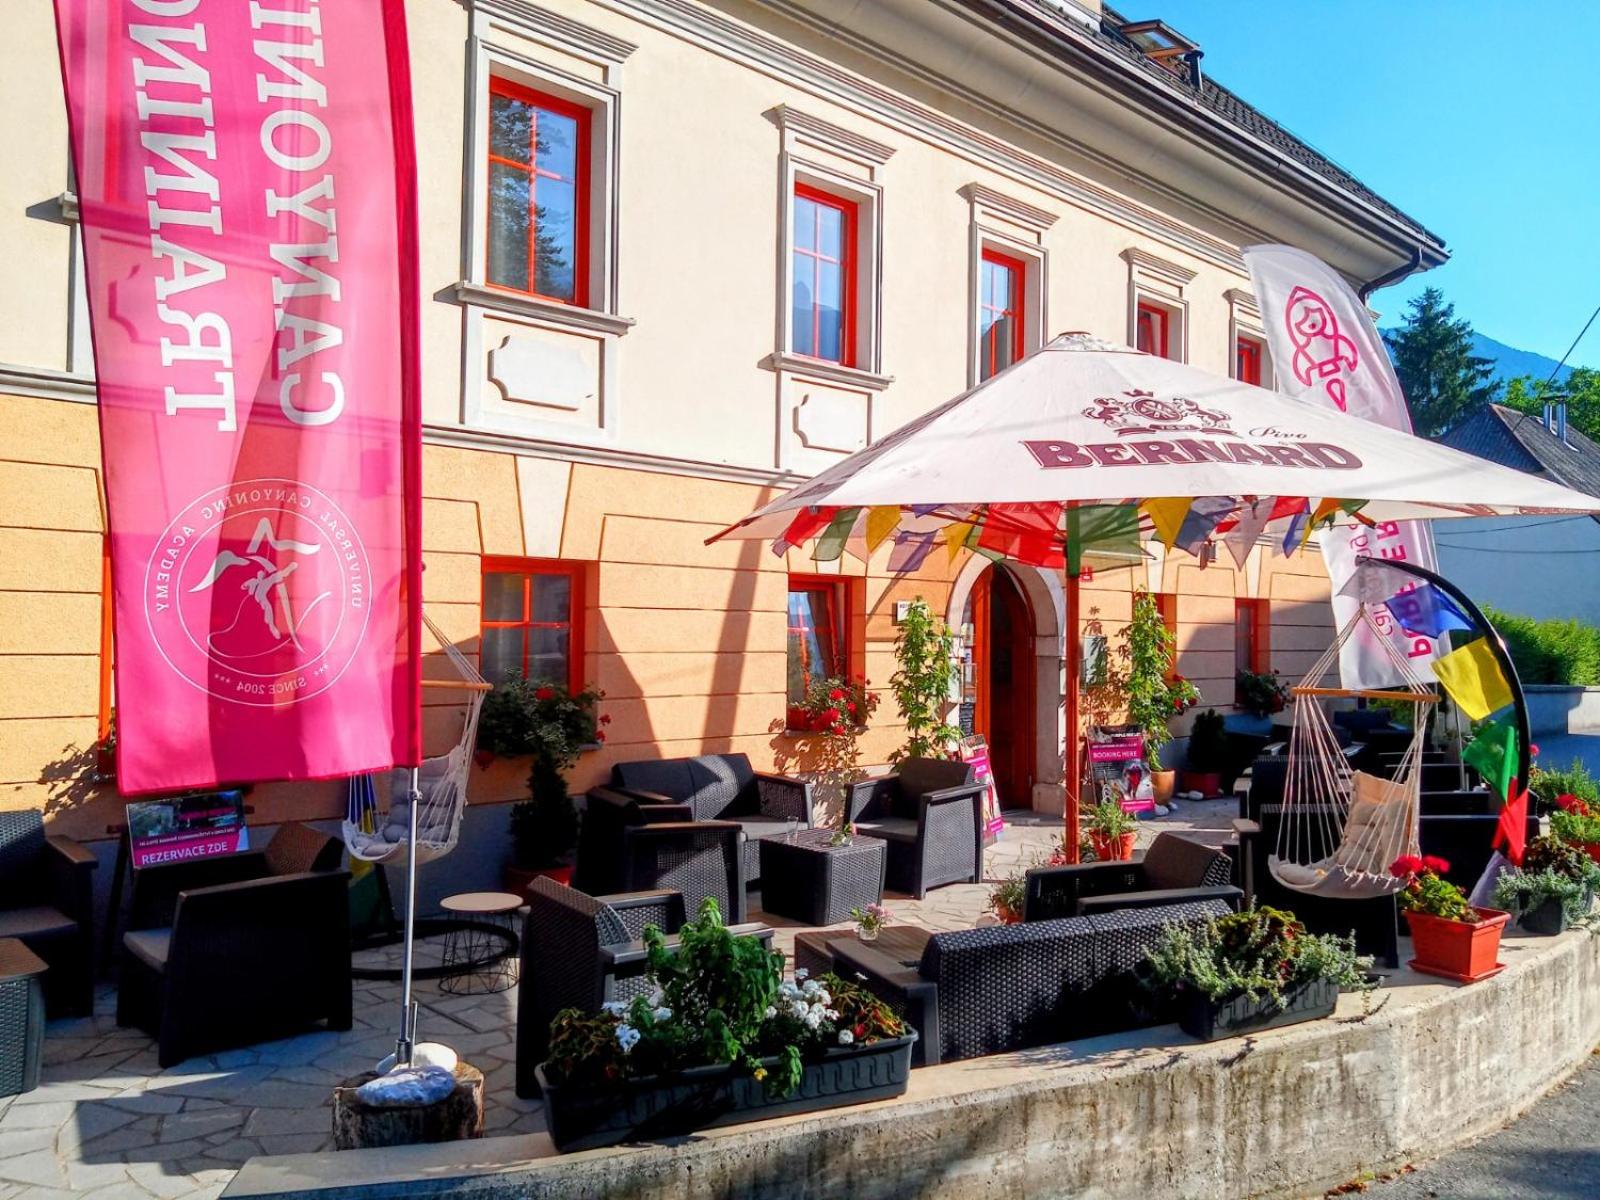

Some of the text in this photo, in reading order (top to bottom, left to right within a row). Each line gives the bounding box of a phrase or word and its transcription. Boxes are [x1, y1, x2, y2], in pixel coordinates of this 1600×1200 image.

[1248, 425, 1307, 439] Pivo
[1020, 438, 1364, 470] BERNARD
[141, 841, 228, 866] REZERVACE ZDE
